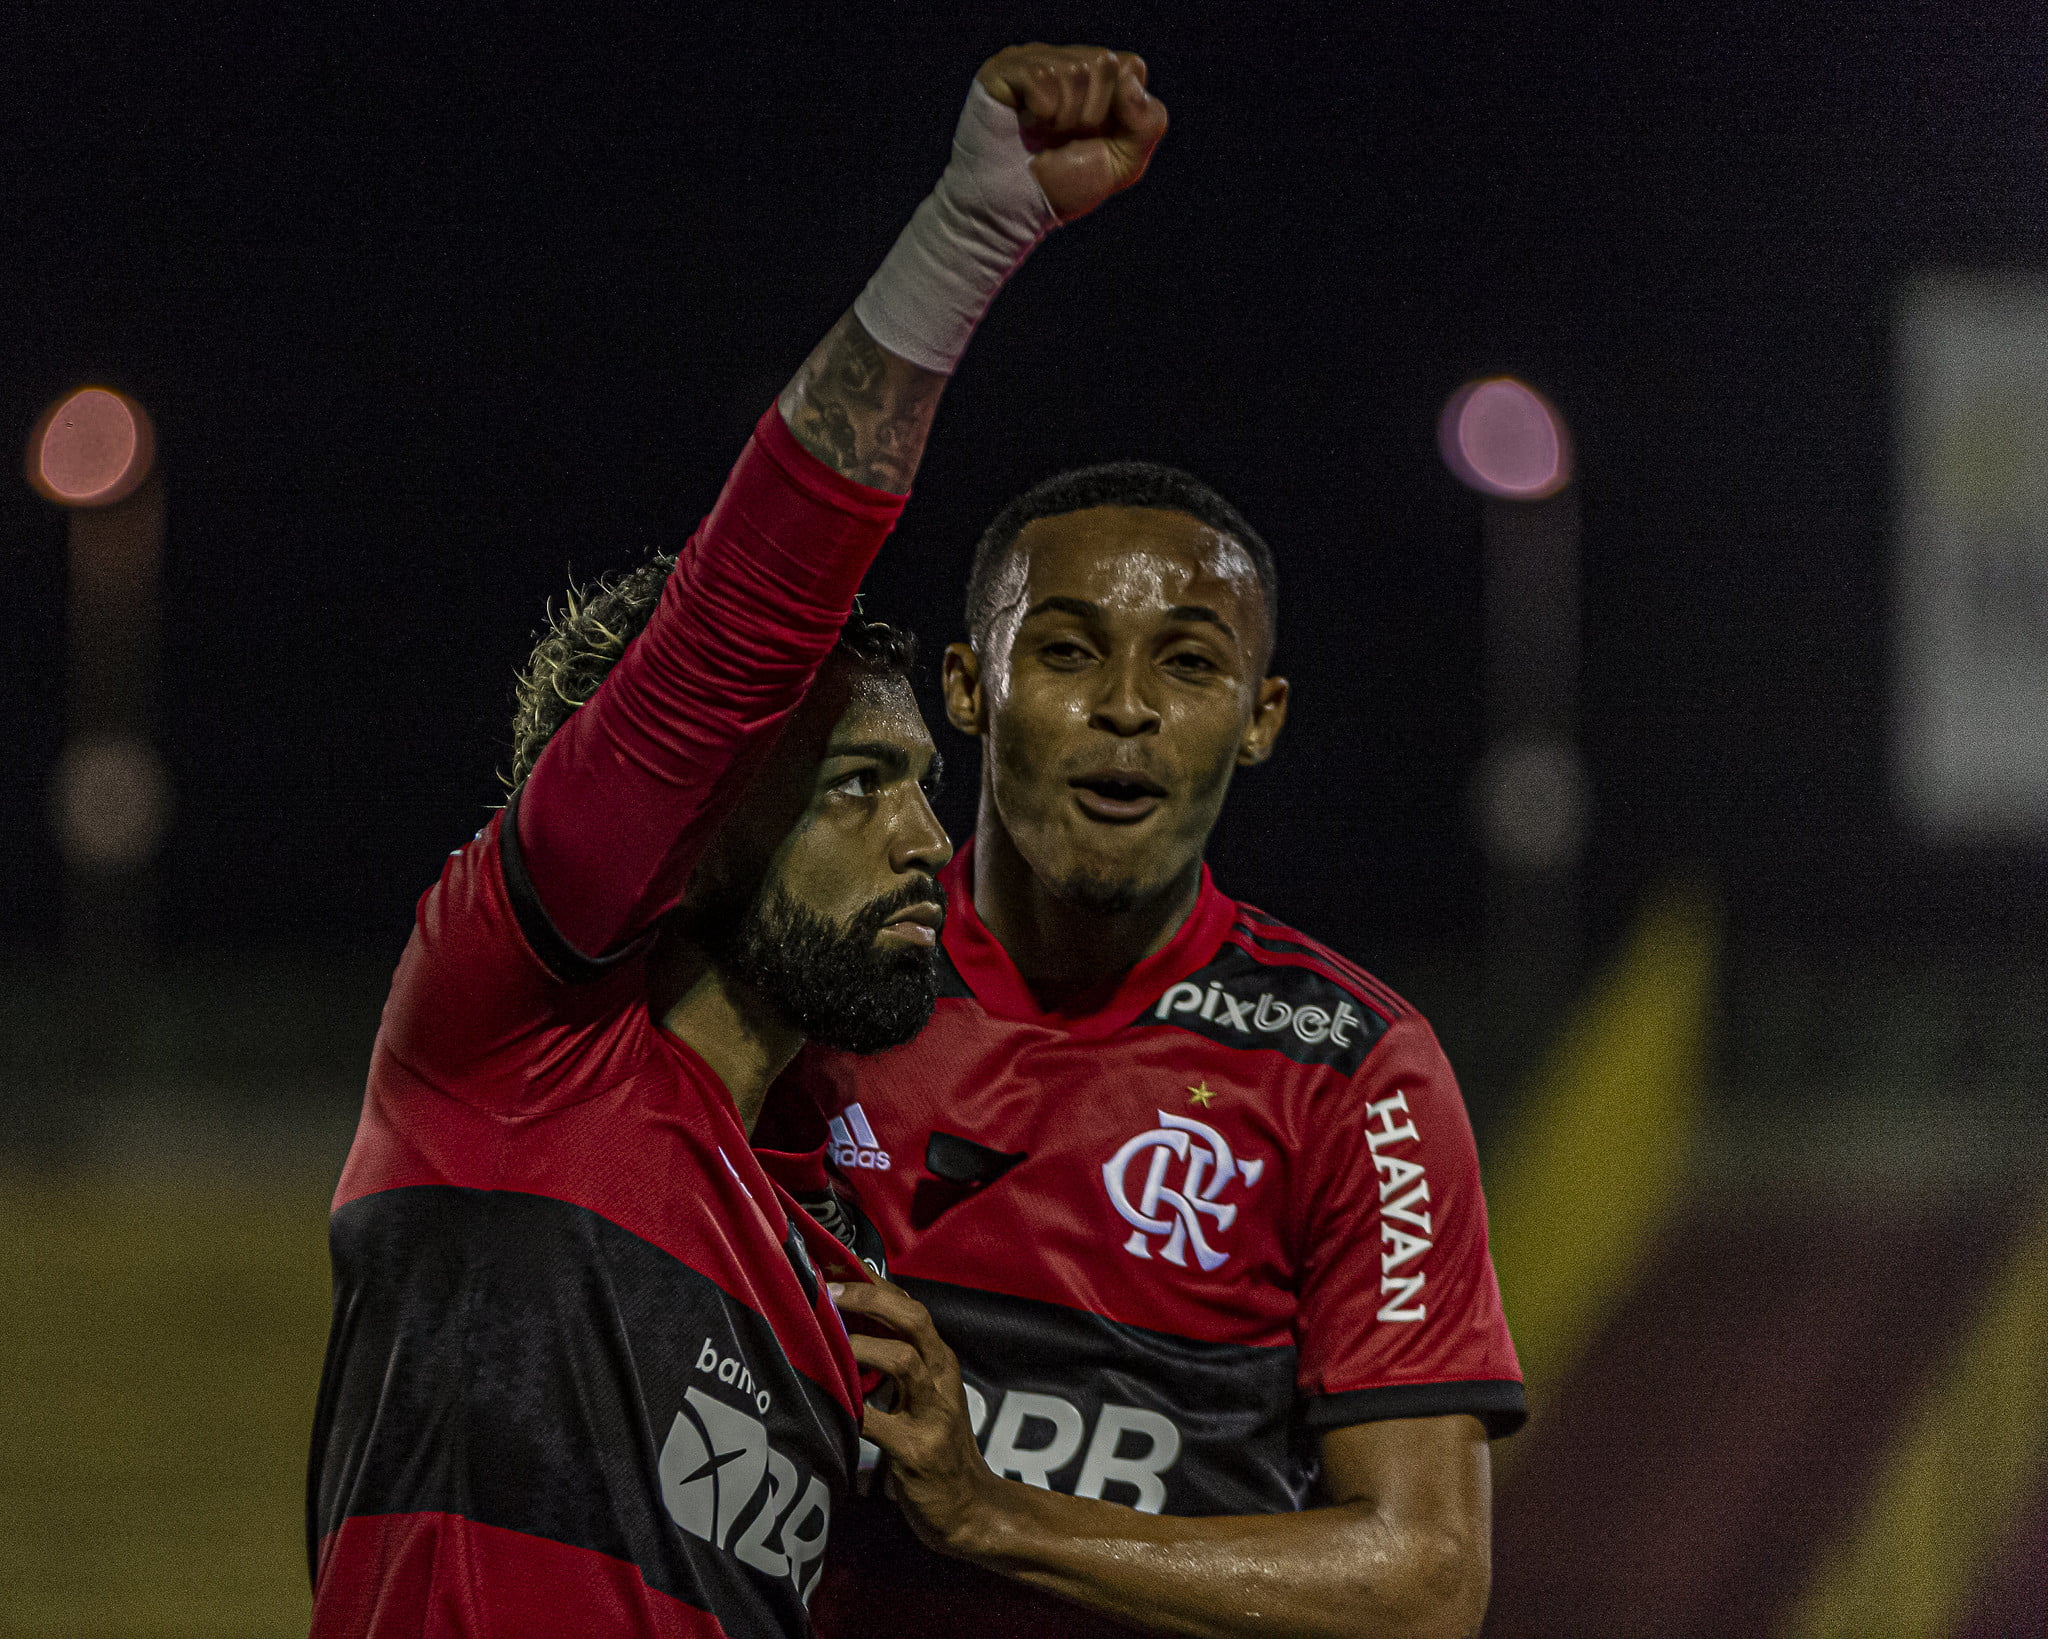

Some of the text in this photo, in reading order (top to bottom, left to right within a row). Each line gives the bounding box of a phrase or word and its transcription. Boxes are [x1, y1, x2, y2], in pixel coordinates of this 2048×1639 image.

[1154, 980, 1360, 1048] pixbet
[1364, 1088, 1434, 1323] HAVAN
[695, 1336, 772, 1415] bano
